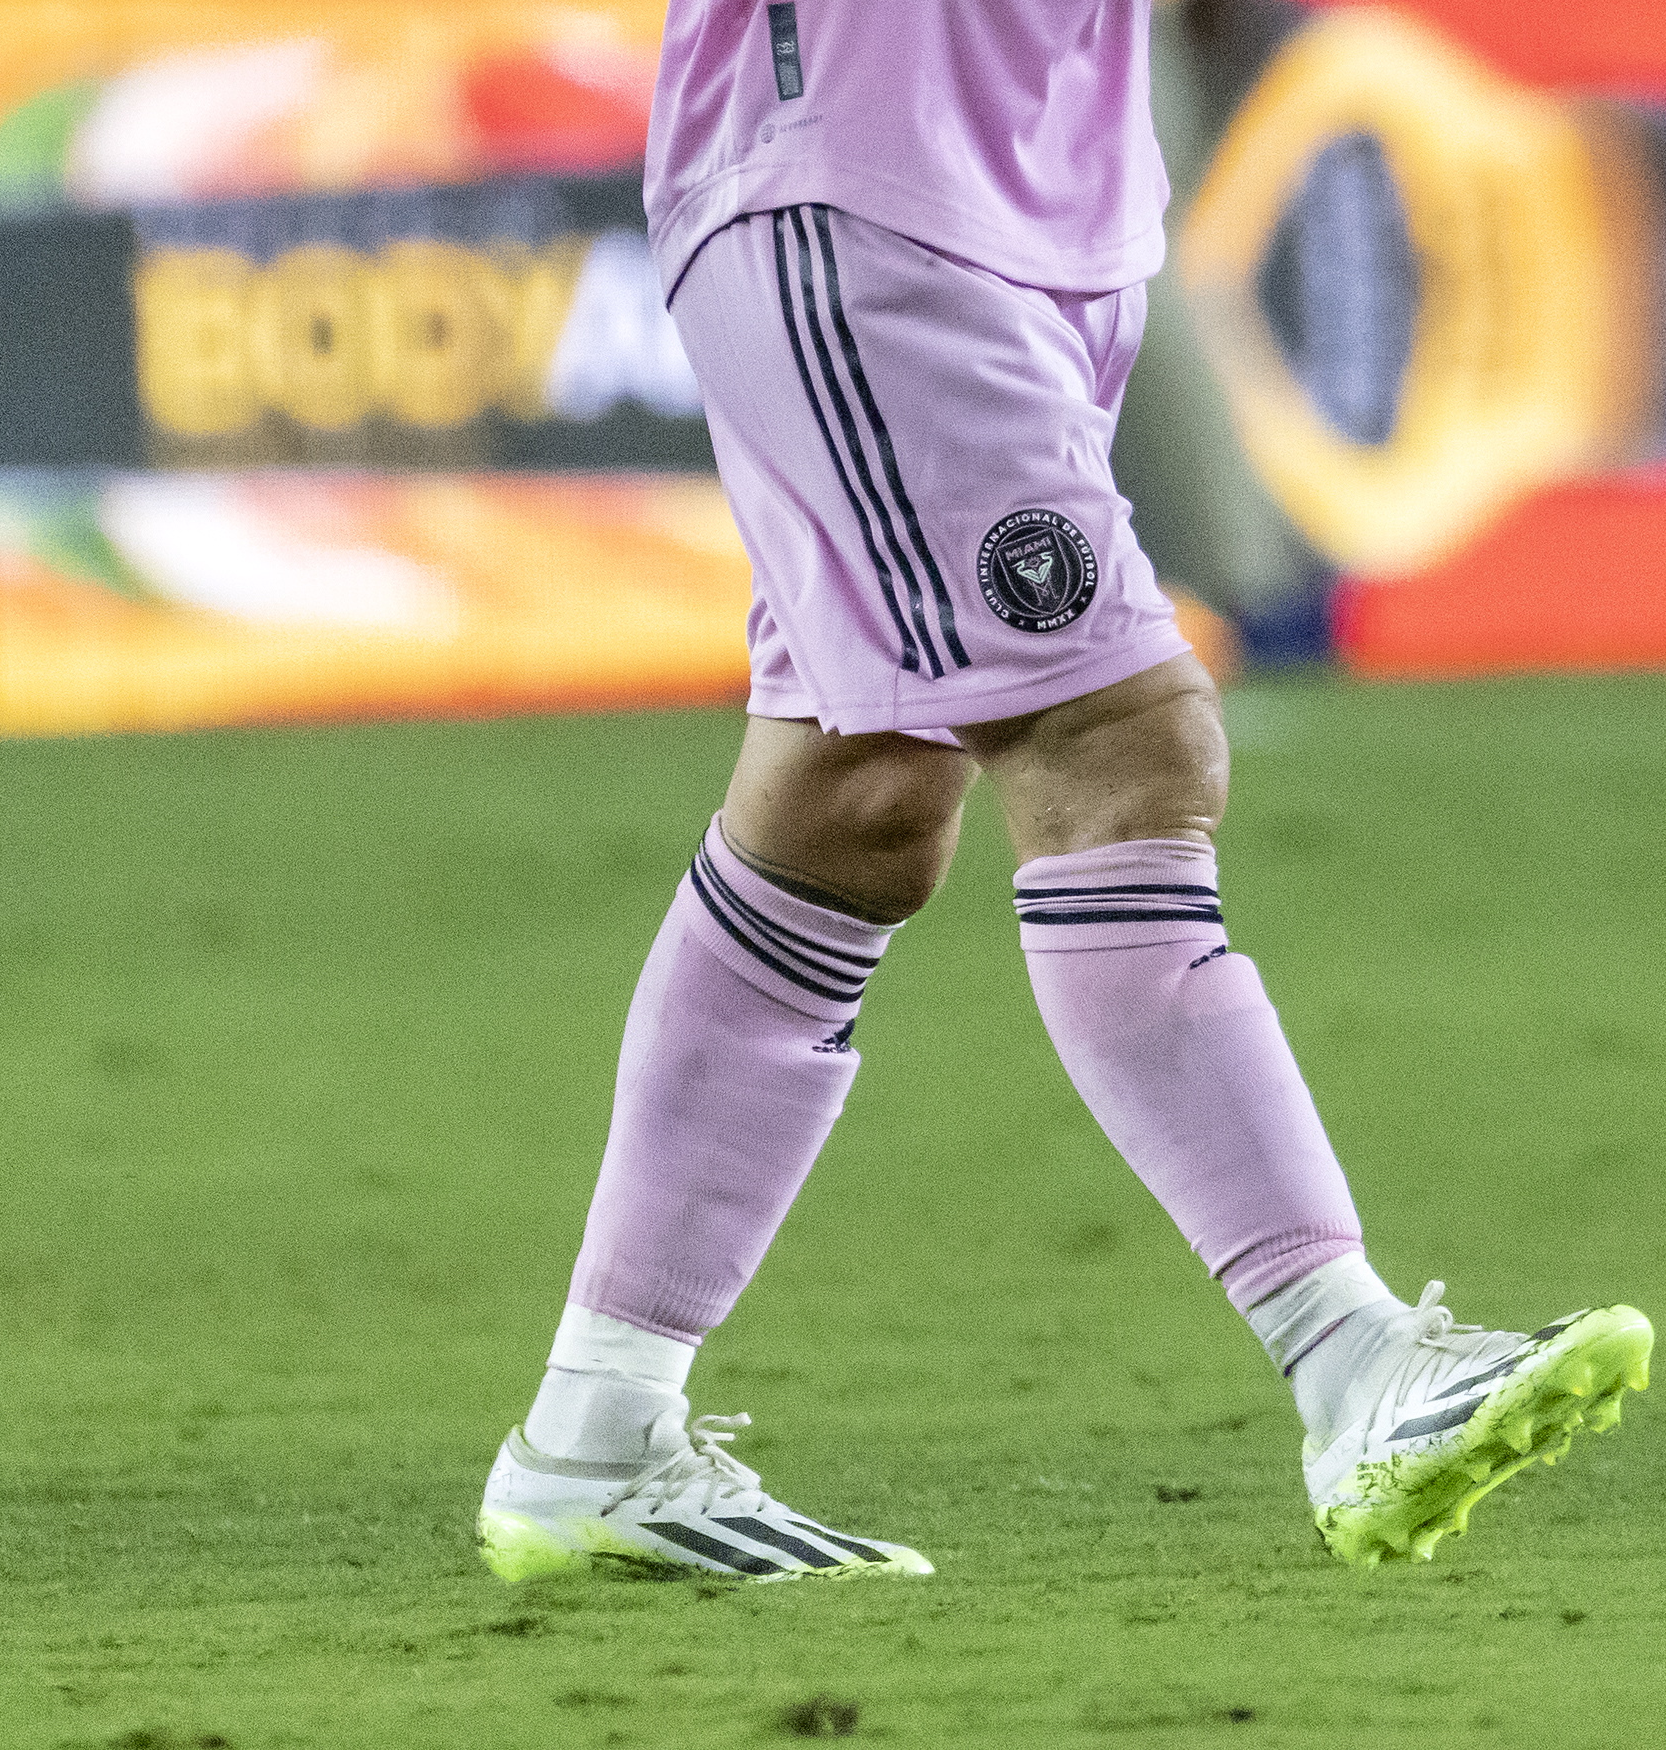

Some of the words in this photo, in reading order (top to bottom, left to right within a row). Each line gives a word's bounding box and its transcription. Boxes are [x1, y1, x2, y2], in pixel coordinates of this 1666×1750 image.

[1062, 521, 1078, 538] DE
[979, 512, 1059, 583] INTERNACIONAL
[1005, 536, 1053, 561] MIAMI
[984, 588, 1010, 619] CLUB
[1037, 608, 1075, 630] MMXX
